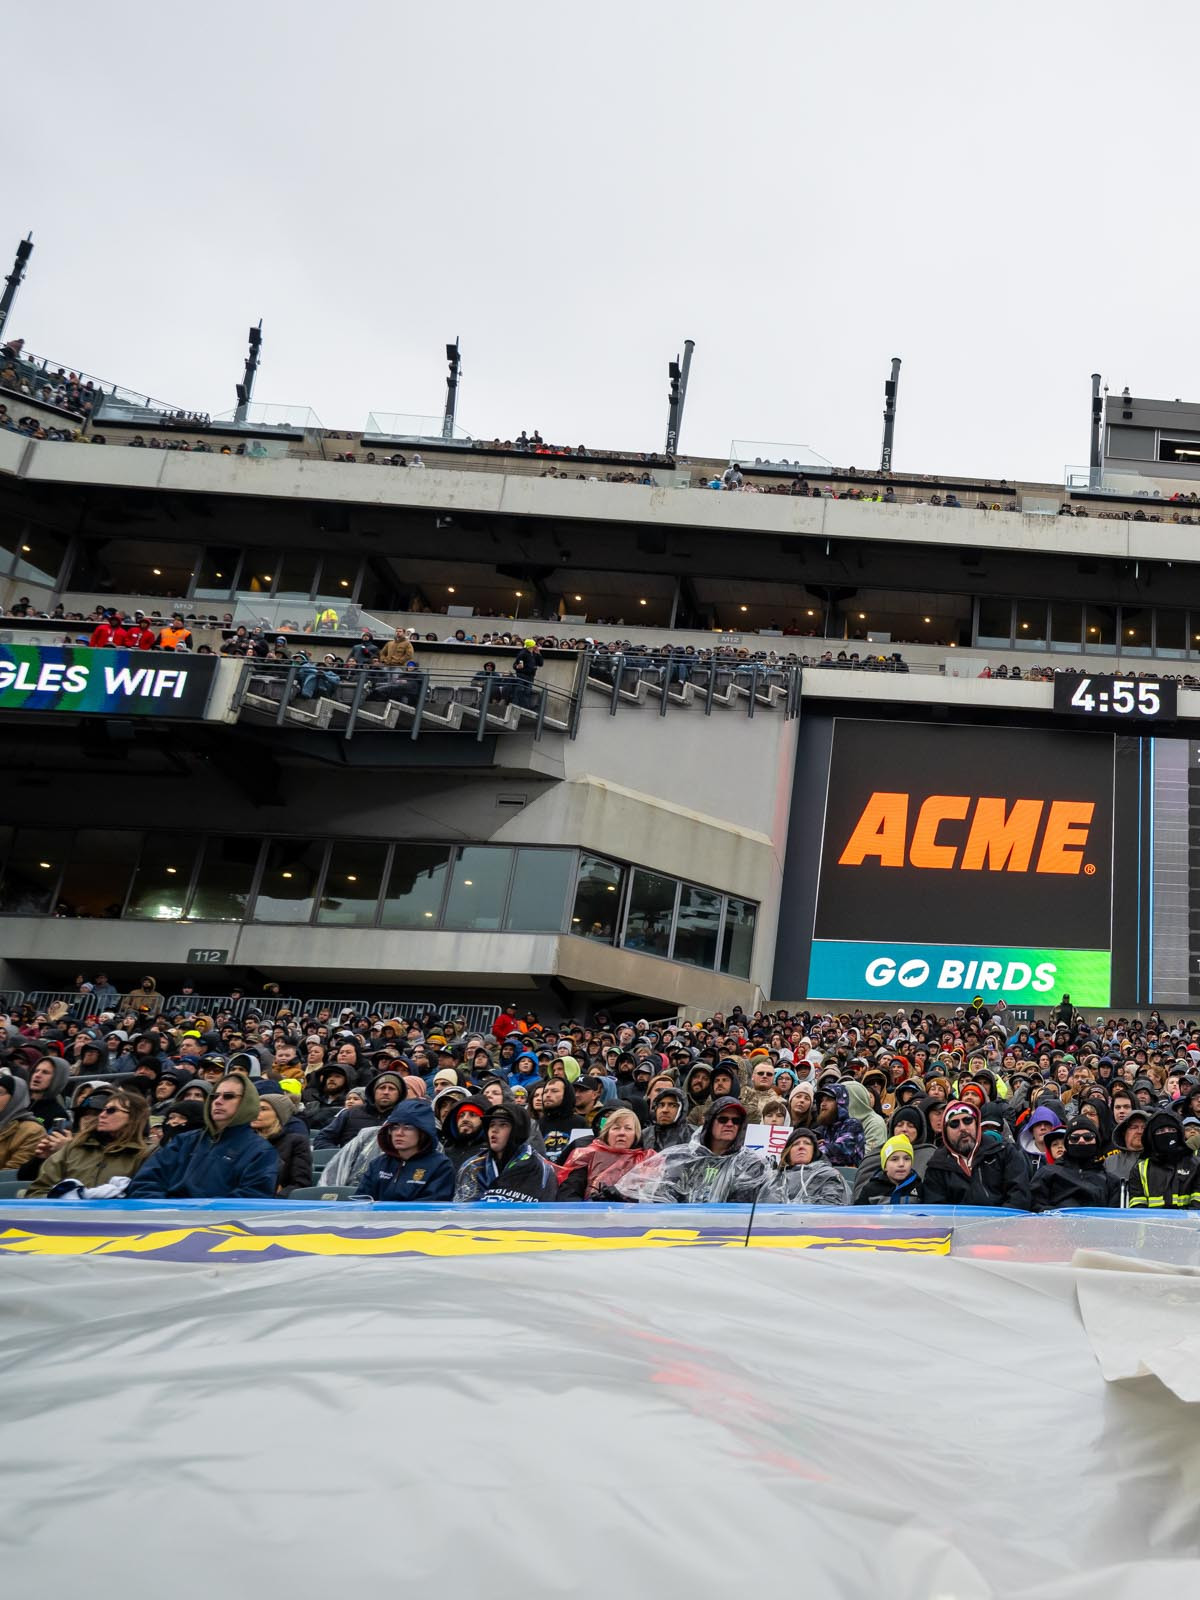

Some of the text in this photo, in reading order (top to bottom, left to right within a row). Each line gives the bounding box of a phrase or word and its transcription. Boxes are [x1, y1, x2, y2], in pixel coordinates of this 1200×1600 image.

[667, 431, 676, 453] 214
[883, 447, 892, 470] 213
[104, 666, 188, 699] WIFI
[1071, 680, 1160, 716] 4:55
[838, 792, 1096, 875] ACME
[194, 951, 221, 963] 112
[865, 957, 1057, 991] GO BIRDS
